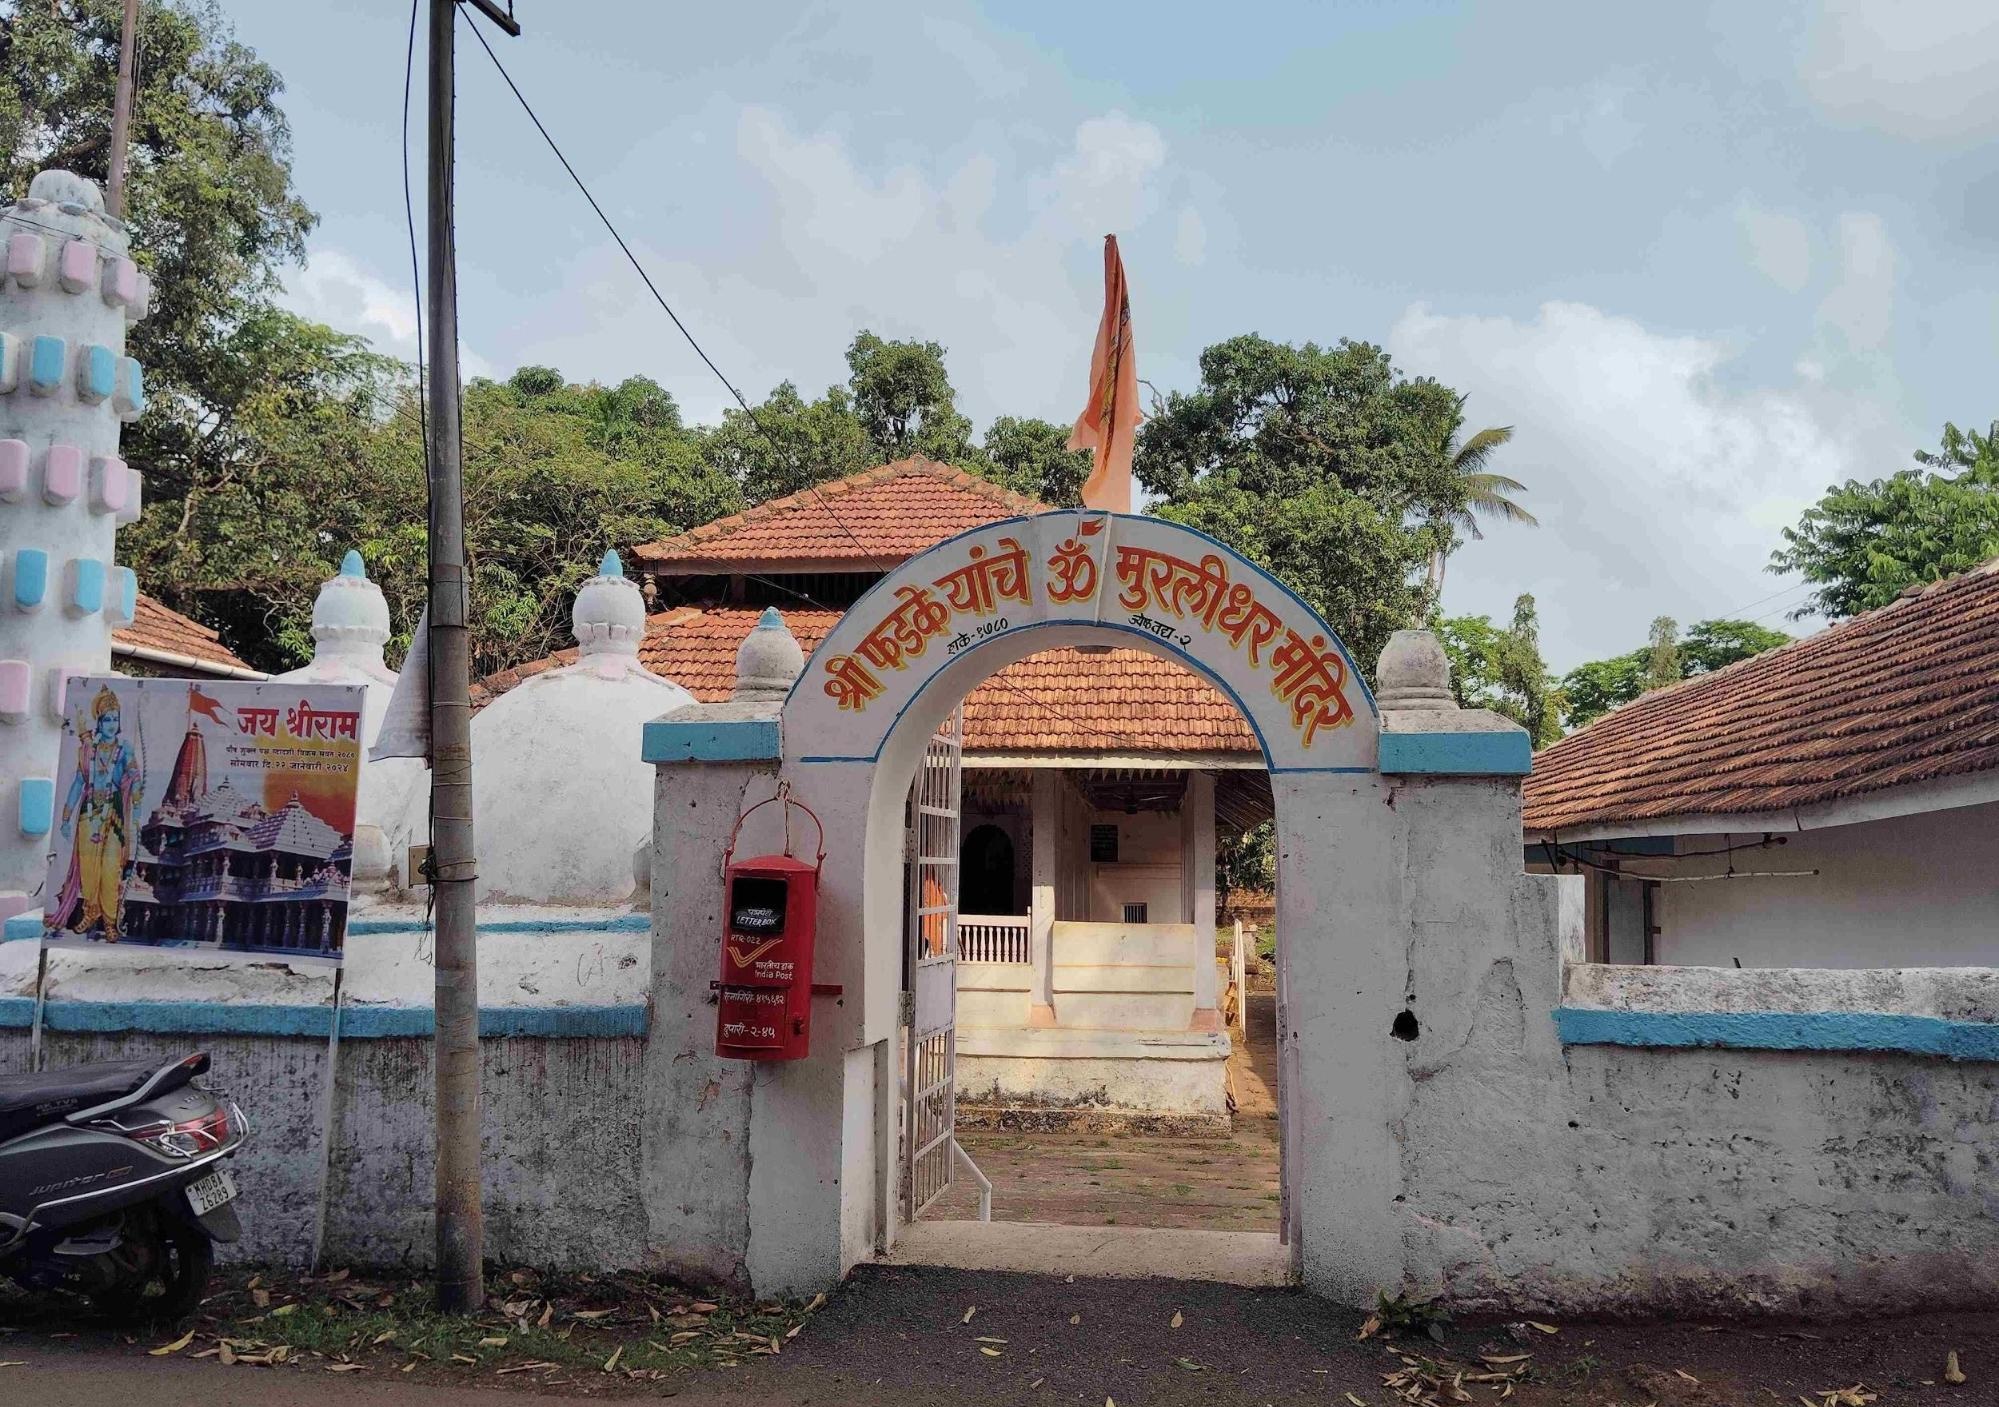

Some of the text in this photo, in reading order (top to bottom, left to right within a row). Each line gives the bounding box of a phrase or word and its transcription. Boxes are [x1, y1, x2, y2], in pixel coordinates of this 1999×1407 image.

[823, 536, 1355, 748] श्री फडके यांचे ॐ मुरलीधर मंदिर
[237, 699, 360, 740] जय श्रीराम
[230, 757, 259, 767] सोमवार
[289, 760, 322, 771] जानेवारी
[326, 763, 349, 772] २०२४
[754, 969, 793, 981] India Post
